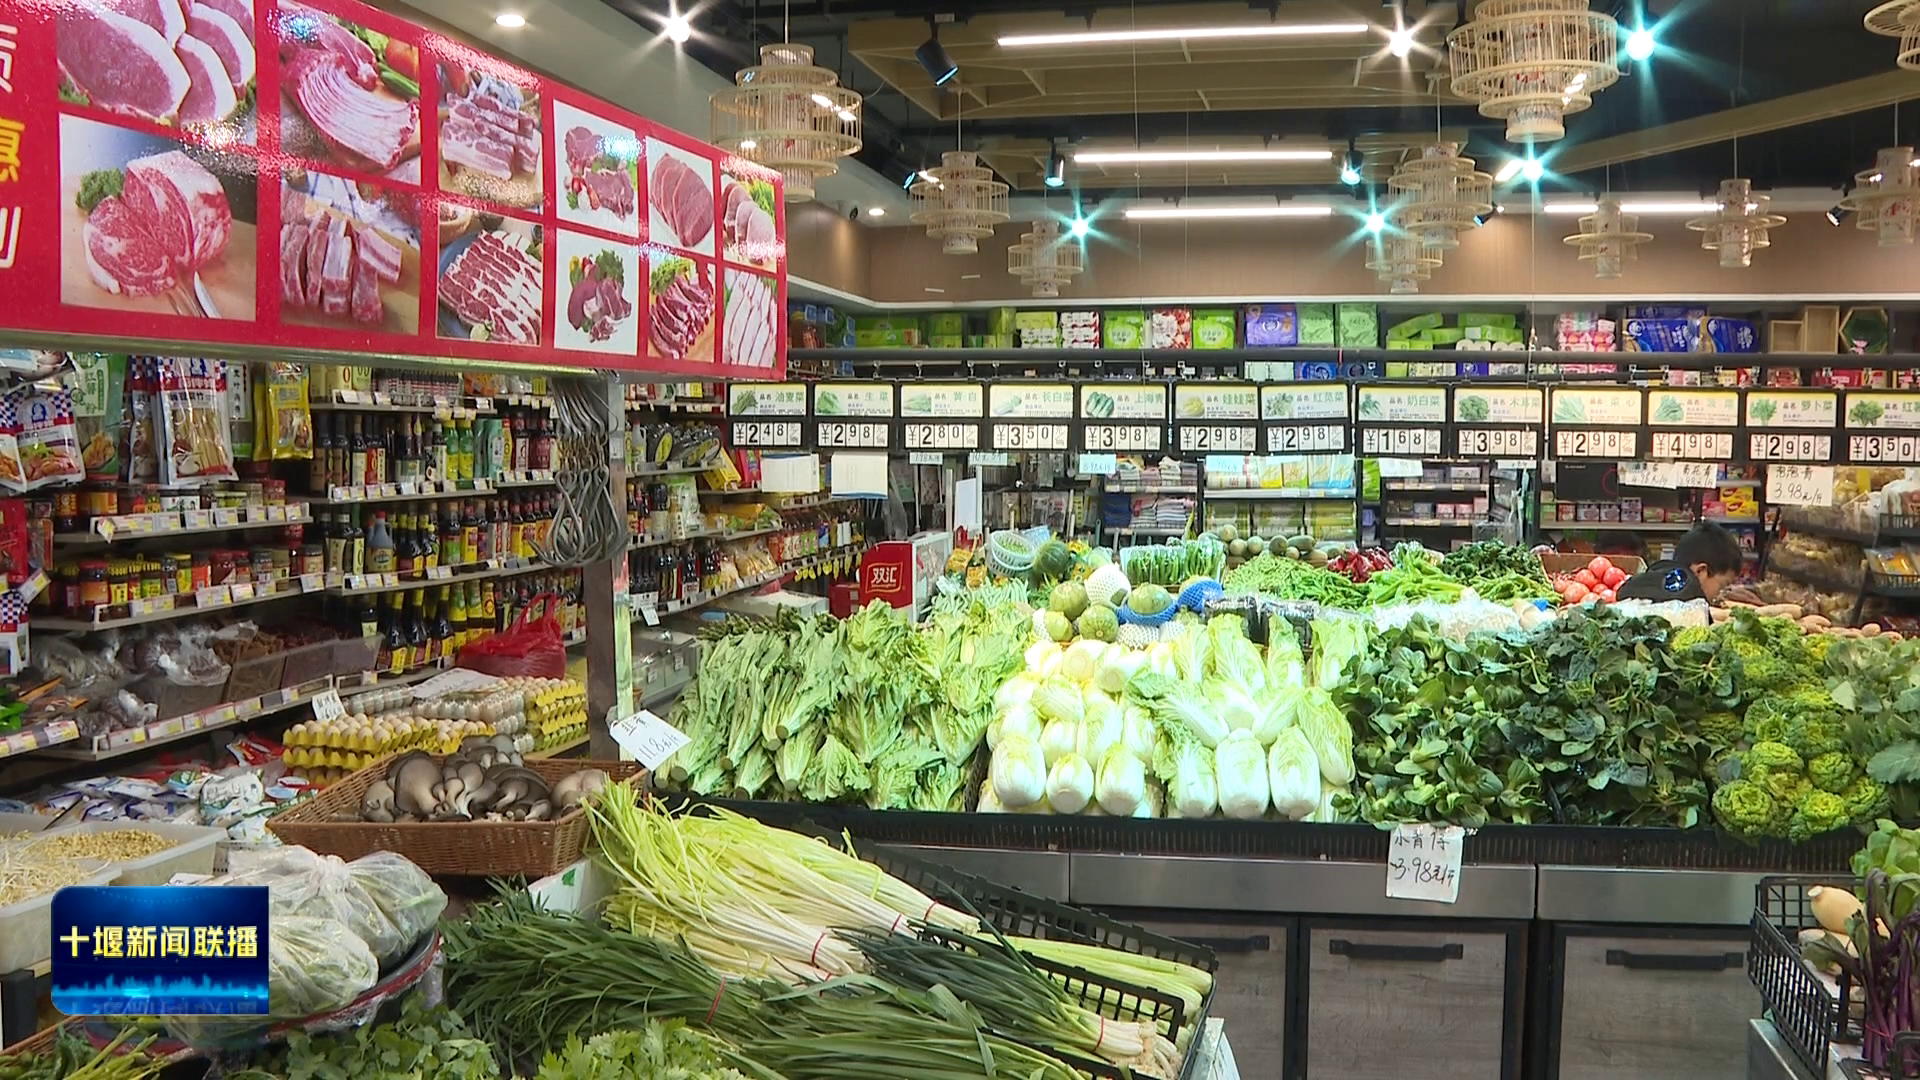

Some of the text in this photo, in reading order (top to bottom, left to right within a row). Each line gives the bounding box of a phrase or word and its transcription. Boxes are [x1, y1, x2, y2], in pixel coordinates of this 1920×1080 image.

[775, 391, 804, 402] 油麦菜
[1137, 393, 1163, 404] 上海青
[1222, 393, 1256, 405] 娃娃菜
[1407, 395, 1440, 407] 奶白菜
[1801, 401, 1832, 412] 萝卜菜
[871, 566, 898, 584] 双汇
